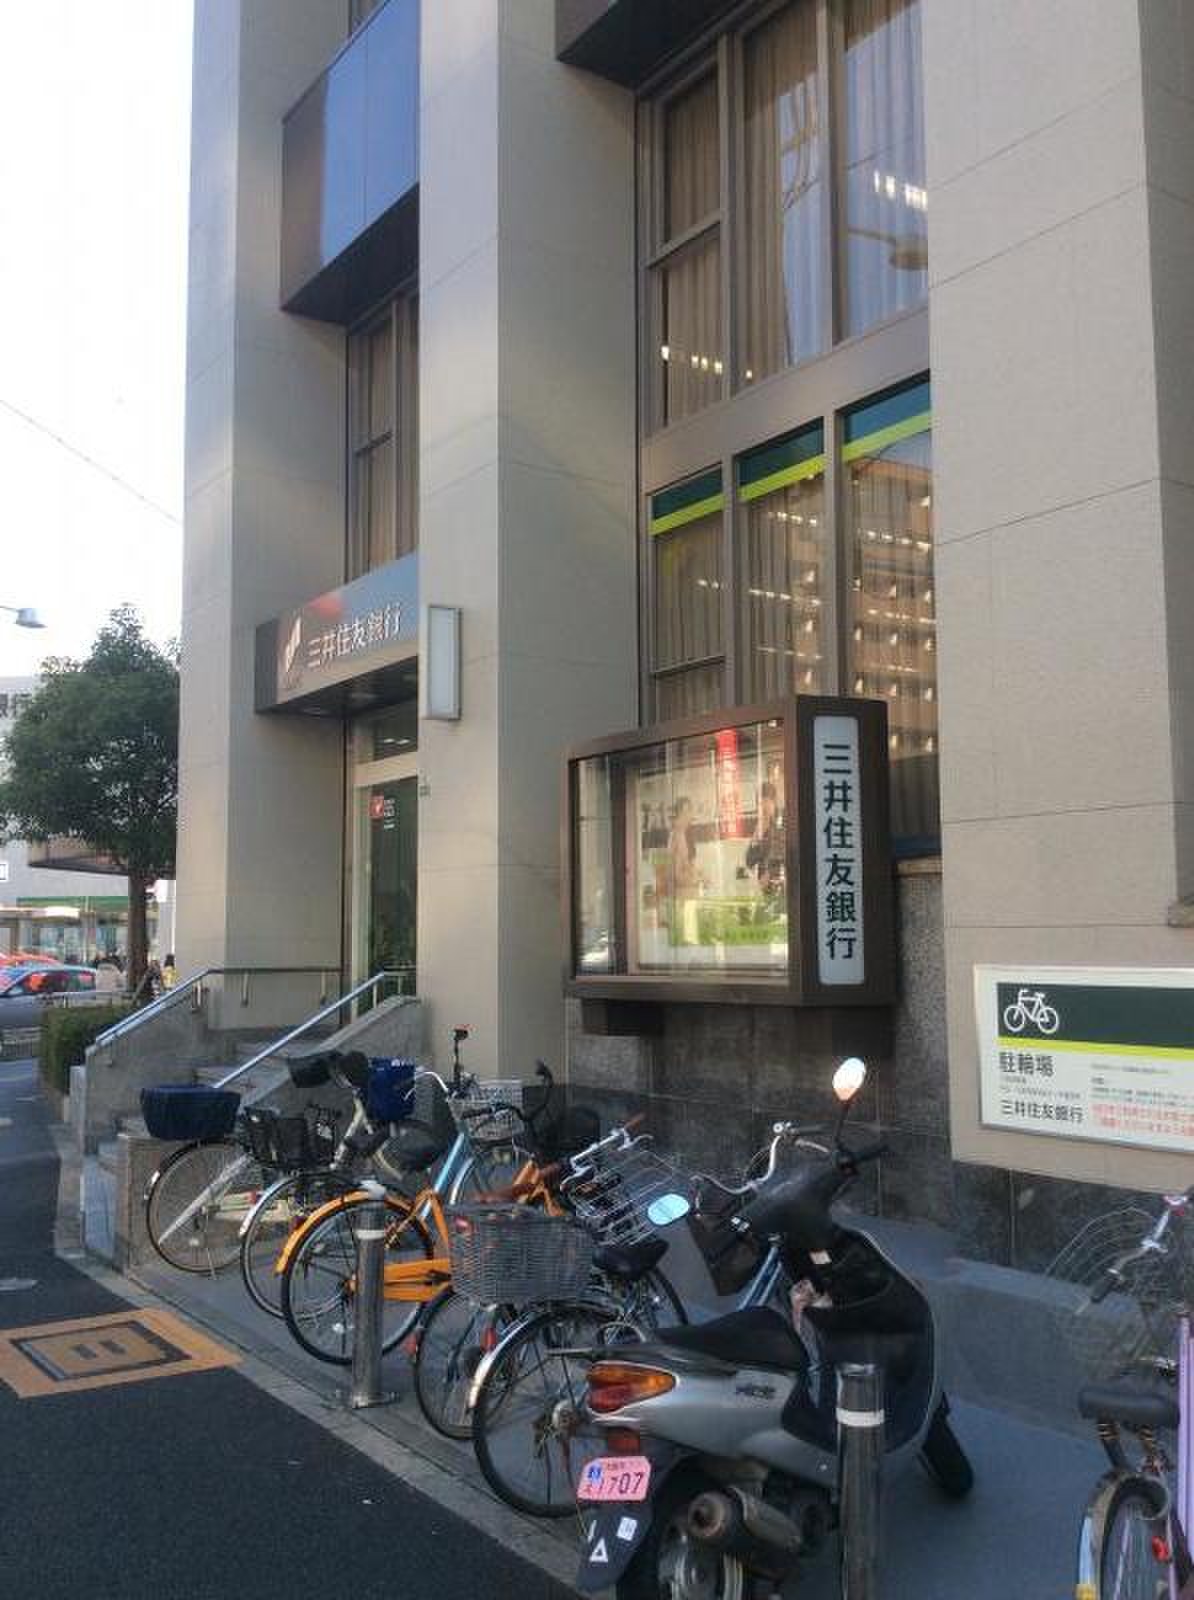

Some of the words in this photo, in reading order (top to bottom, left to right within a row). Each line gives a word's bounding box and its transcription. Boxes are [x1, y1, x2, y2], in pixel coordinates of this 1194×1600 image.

[823, 743, 857, 960] 三井住友銀行
[1000, 1099, 1083, 1123] 三井住友銀行
